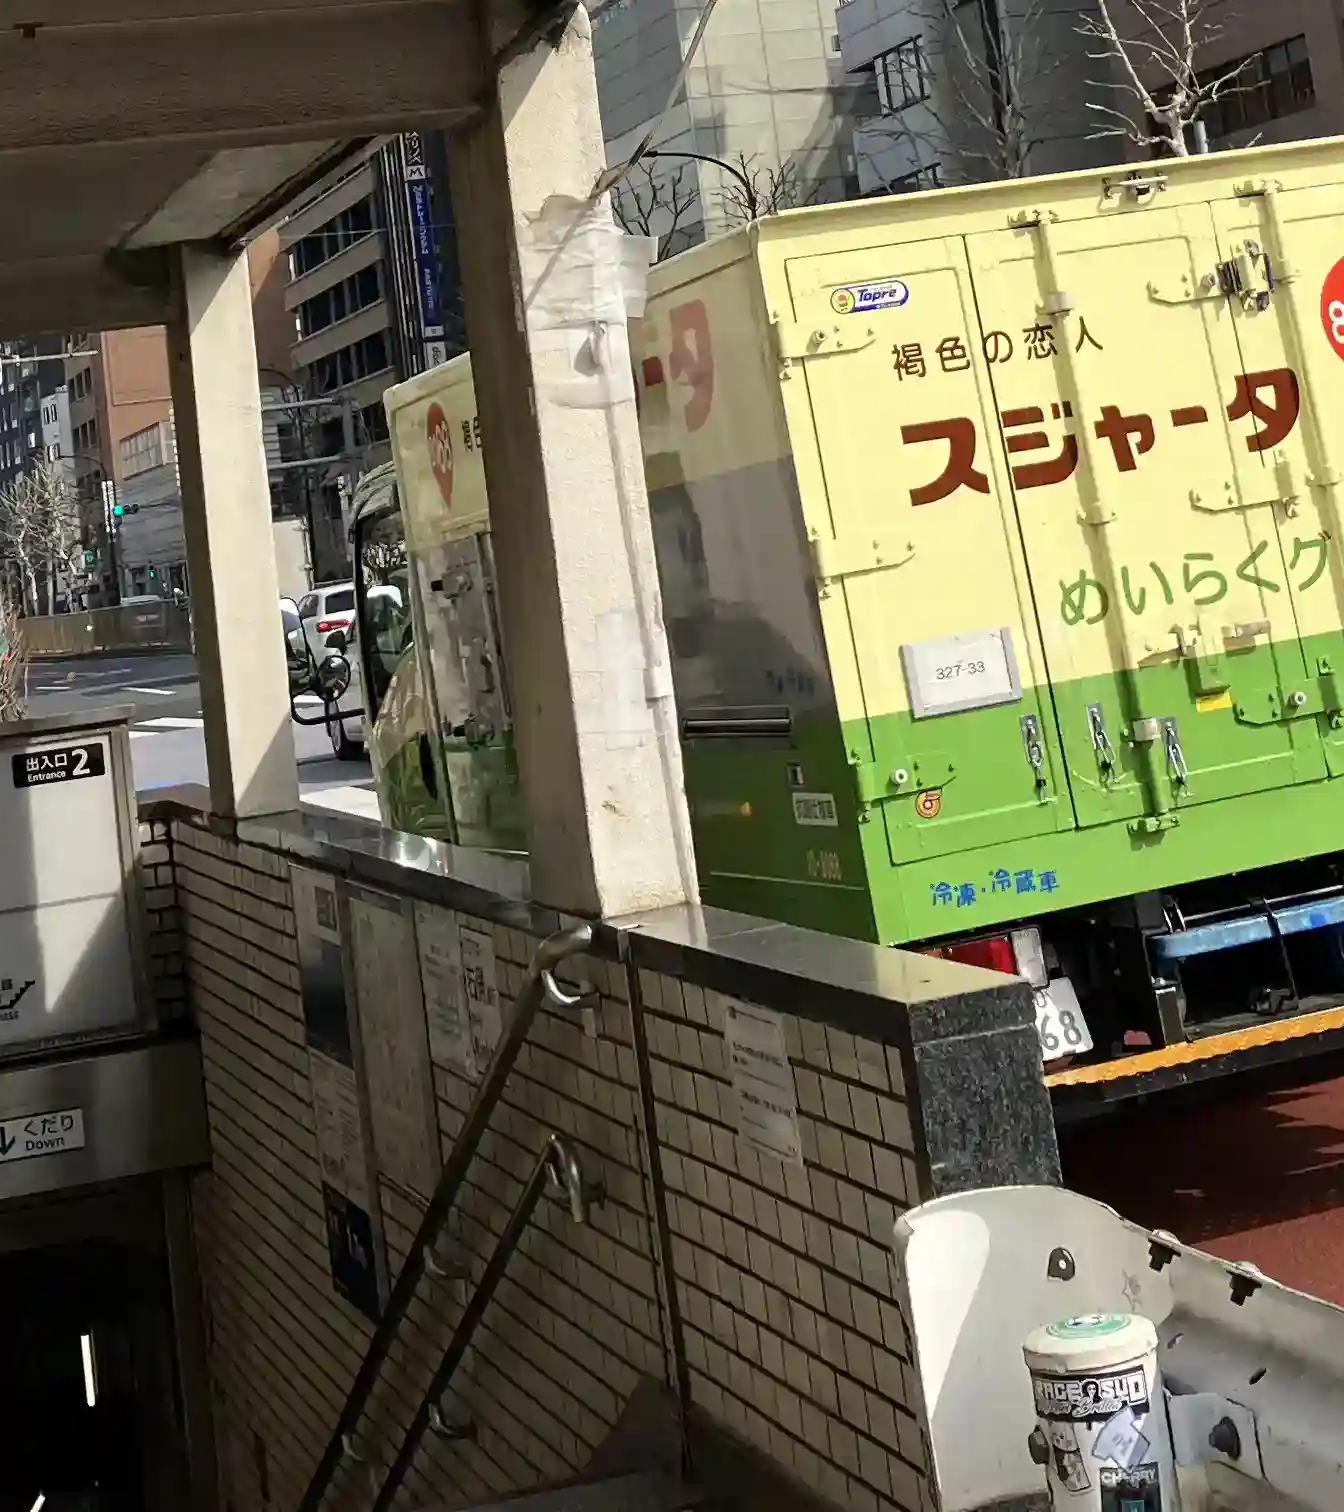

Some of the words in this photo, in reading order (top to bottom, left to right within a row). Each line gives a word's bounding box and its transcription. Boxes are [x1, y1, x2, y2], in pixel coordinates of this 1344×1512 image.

[857, 288, 897, 302] Topre
[891, 324, 1104, 381] 褐色の恋人
[900, 367, 1301, 506] スジャータ
[935, 660, 987, 682] 327-33
[26, 753, 68, 772] 出入口
[71, 748, 91, 776] 2
[27, 770, 67, 783] Entrance
[929, 868, 1060, 908] 冷凍・冷蔵車
[23, 1114, 74, 1137] くだり
[25, 1137, 65, 1152] Down
